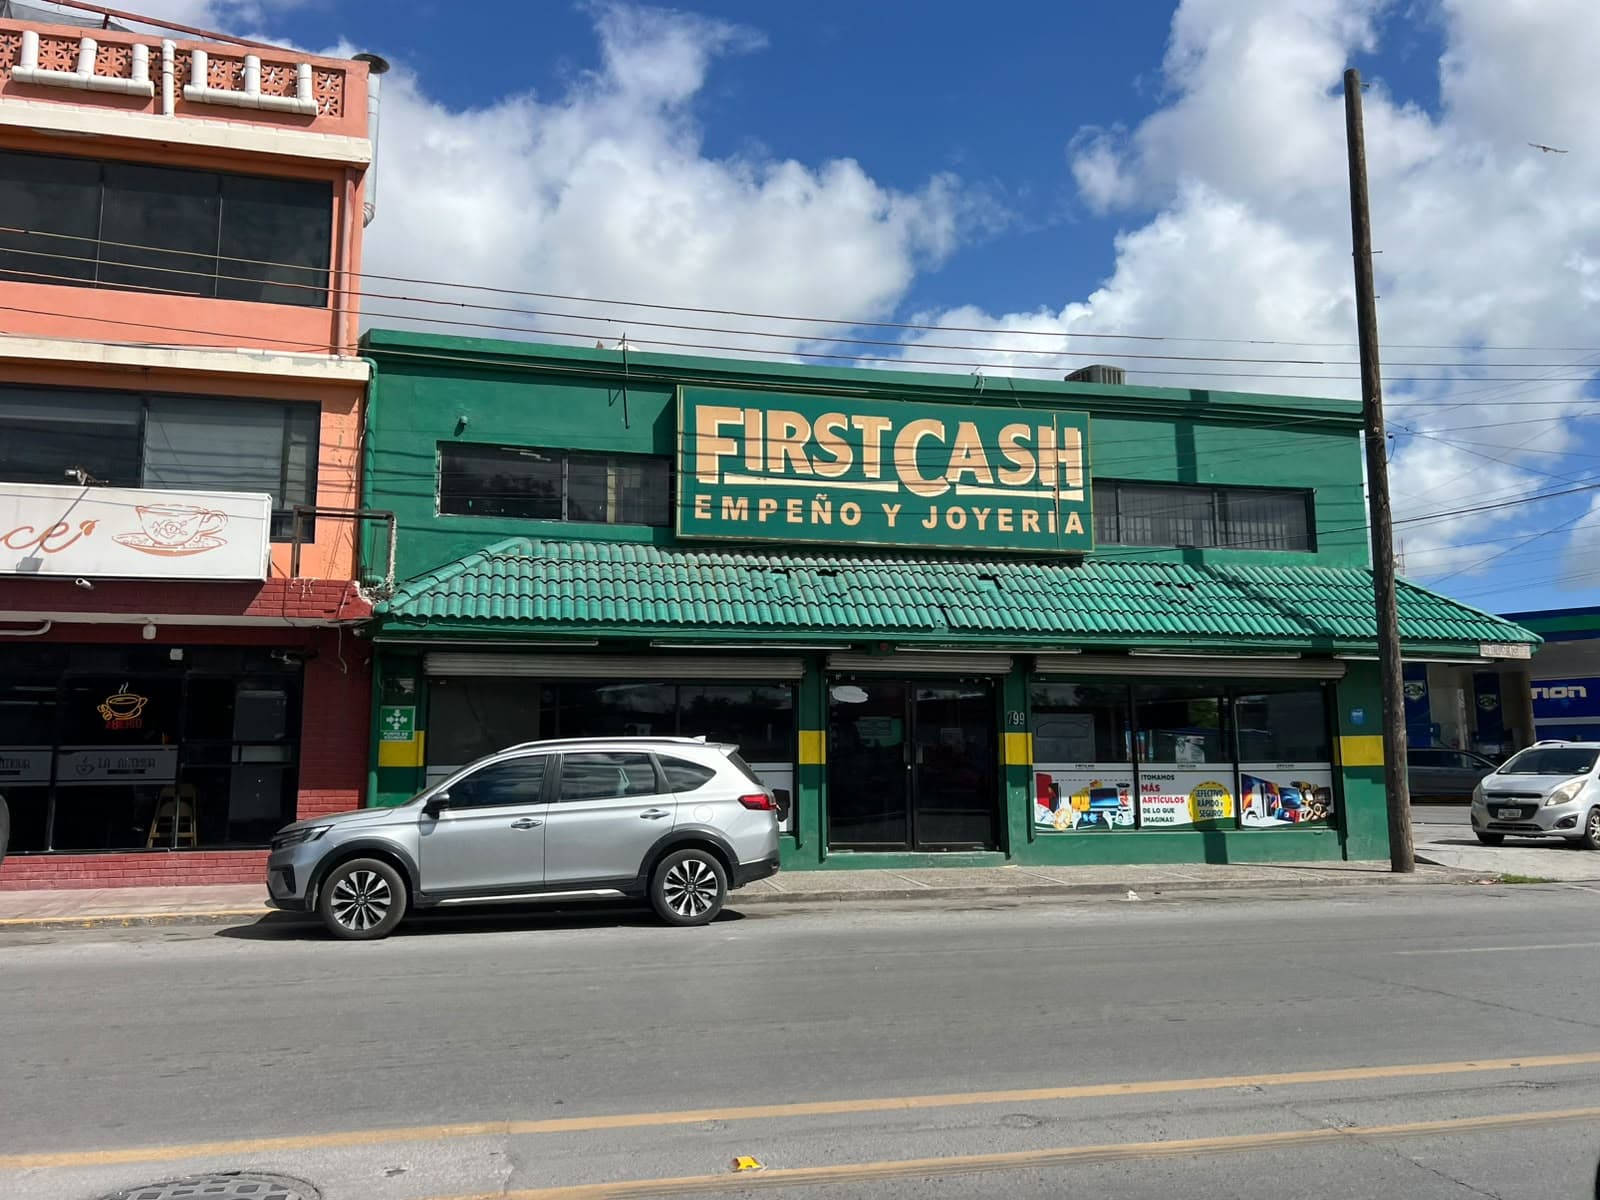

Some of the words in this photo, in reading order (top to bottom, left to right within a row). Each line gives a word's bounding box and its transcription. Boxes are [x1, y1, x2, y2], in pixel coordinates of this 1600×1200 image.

[696, 405, 1084, 497] FIRSTCASH
[694, 493, 862, 527] EMPEÑO
[882, 503, 902, 528] Y
[921, 505, 1085, 535] JOYERIA
[1140, 782, 1161, 793] MÁS
[1142, 795, 1185, 804] ARTÍCULOS
